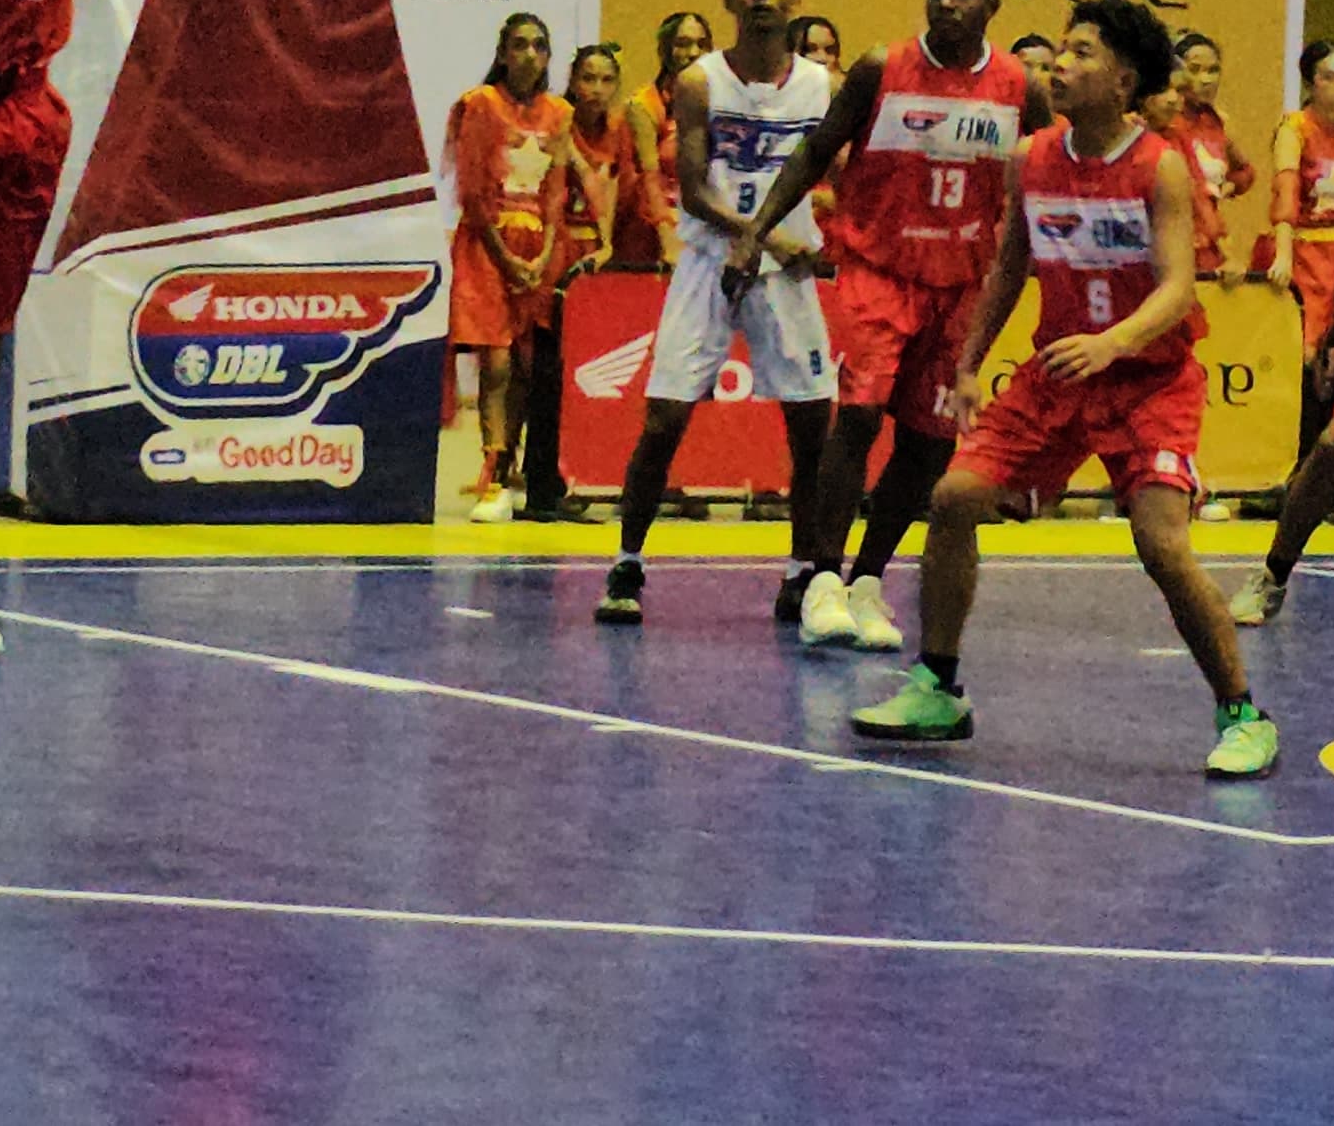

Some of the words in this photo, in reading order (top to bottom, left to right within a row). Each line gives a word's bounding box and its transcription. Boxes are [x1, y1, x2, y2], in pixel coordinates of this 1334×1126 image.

[929, 167, 966, 209] 13
[213, 294, 368, 321] HONDA
[208, 344, 288, 384] DBL
